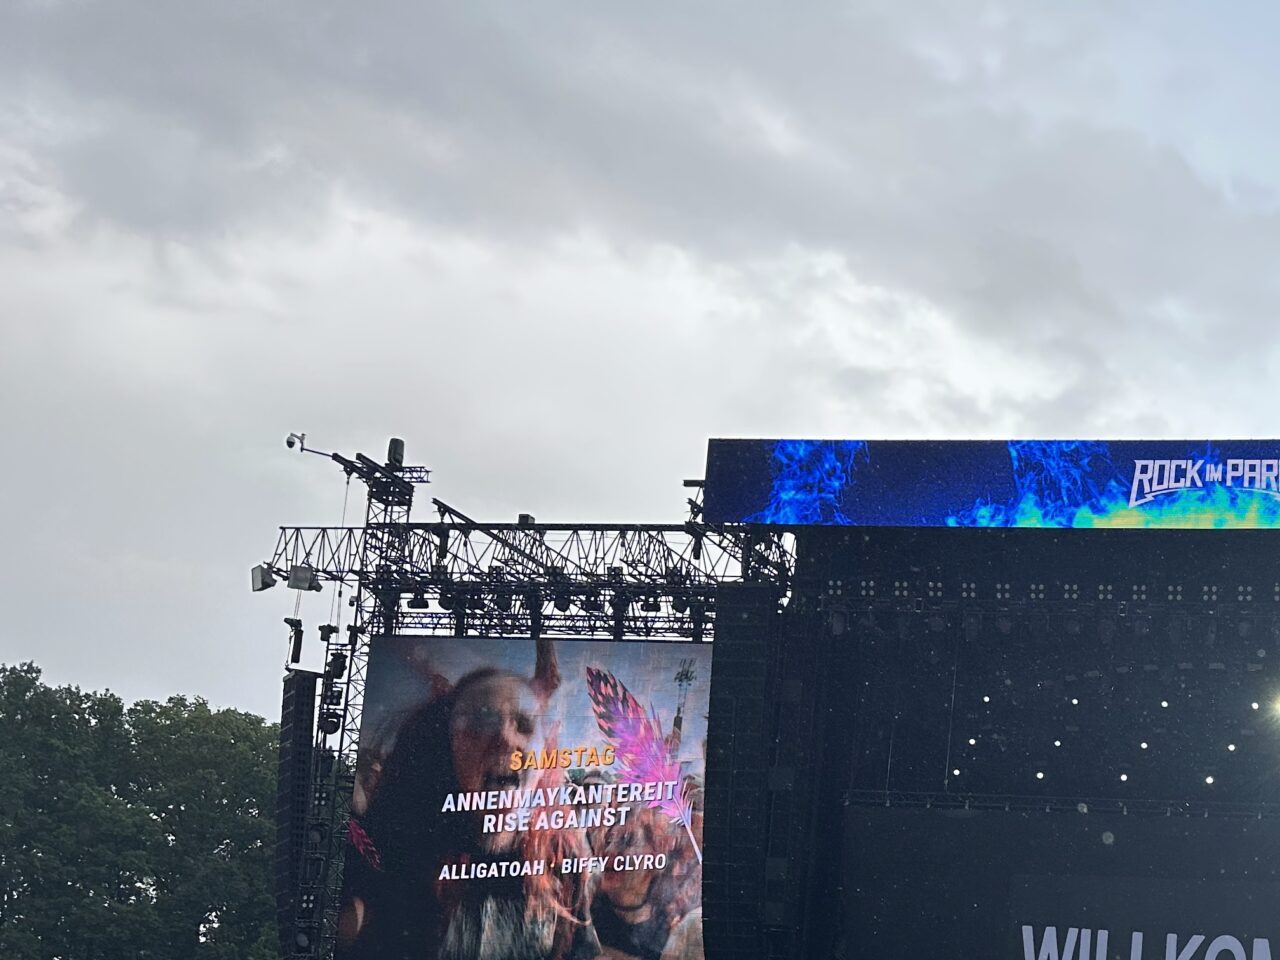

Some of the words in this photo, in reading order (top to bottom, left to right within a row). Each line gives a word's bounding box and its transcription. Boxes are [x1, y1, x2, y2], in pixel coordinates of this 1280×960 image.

[1129, 460, 1205, 508] ROCK
[1206, 463, 1222, 482] IM
[510, 745, 616, 771] SAMSTAG
[441, 781, 678, 812] ANNENMAYKANTEREIT
[483, 811, 531, 833] RISE
[535, 807, 630, 831] AGAINST
[439, 860, 545, 880] ALLIGATOAH
[561, 856, 608, 874] BIFFY
[613, 854, 666, 872] CLYRO
